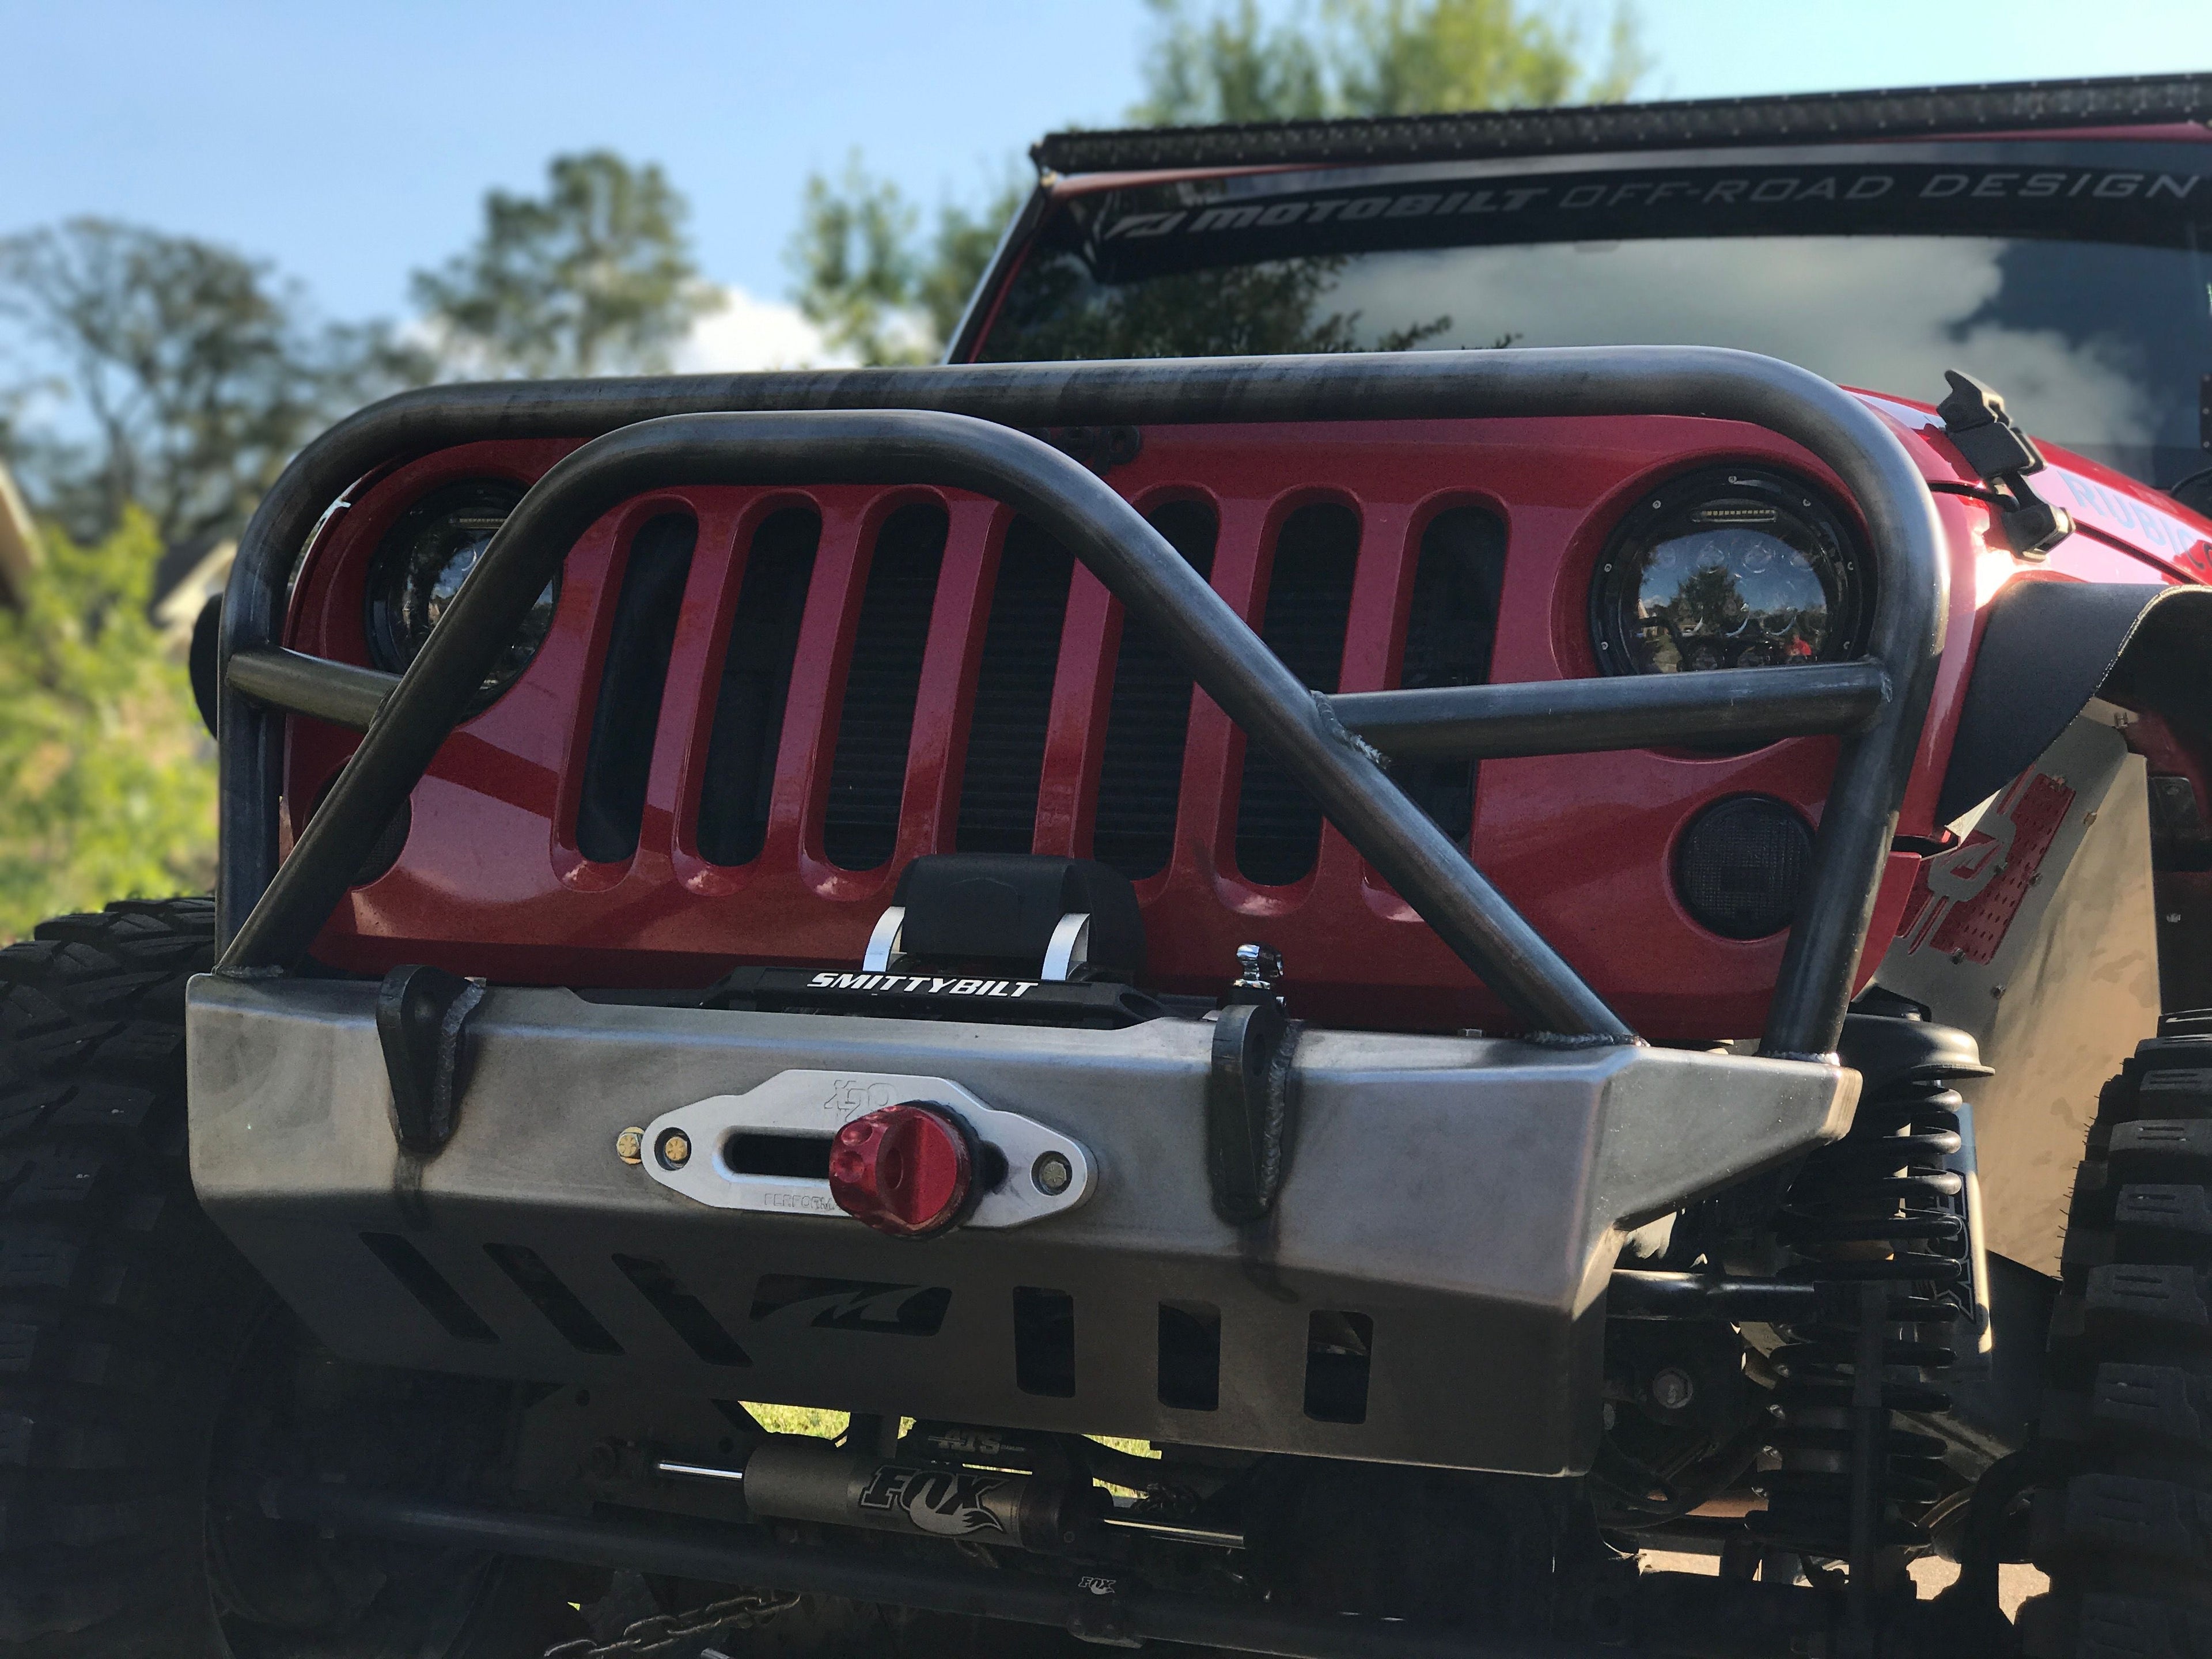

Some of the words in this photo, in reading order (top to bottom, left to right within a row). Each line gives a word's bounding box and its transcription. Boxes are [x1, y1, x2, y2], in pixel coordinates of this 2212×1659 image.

[1187, 188, 1550, 231] MOTOBILT
[1559, 176, 1893, 208] OFF-ROAD
[1919, 173, 2199, 199] DESIGN
[807, 972, 1038, 998] SMITTYBILT
[859, 1465, 1010, 1535] FOX
[1078, 1576, 1117, 1595] FOX
